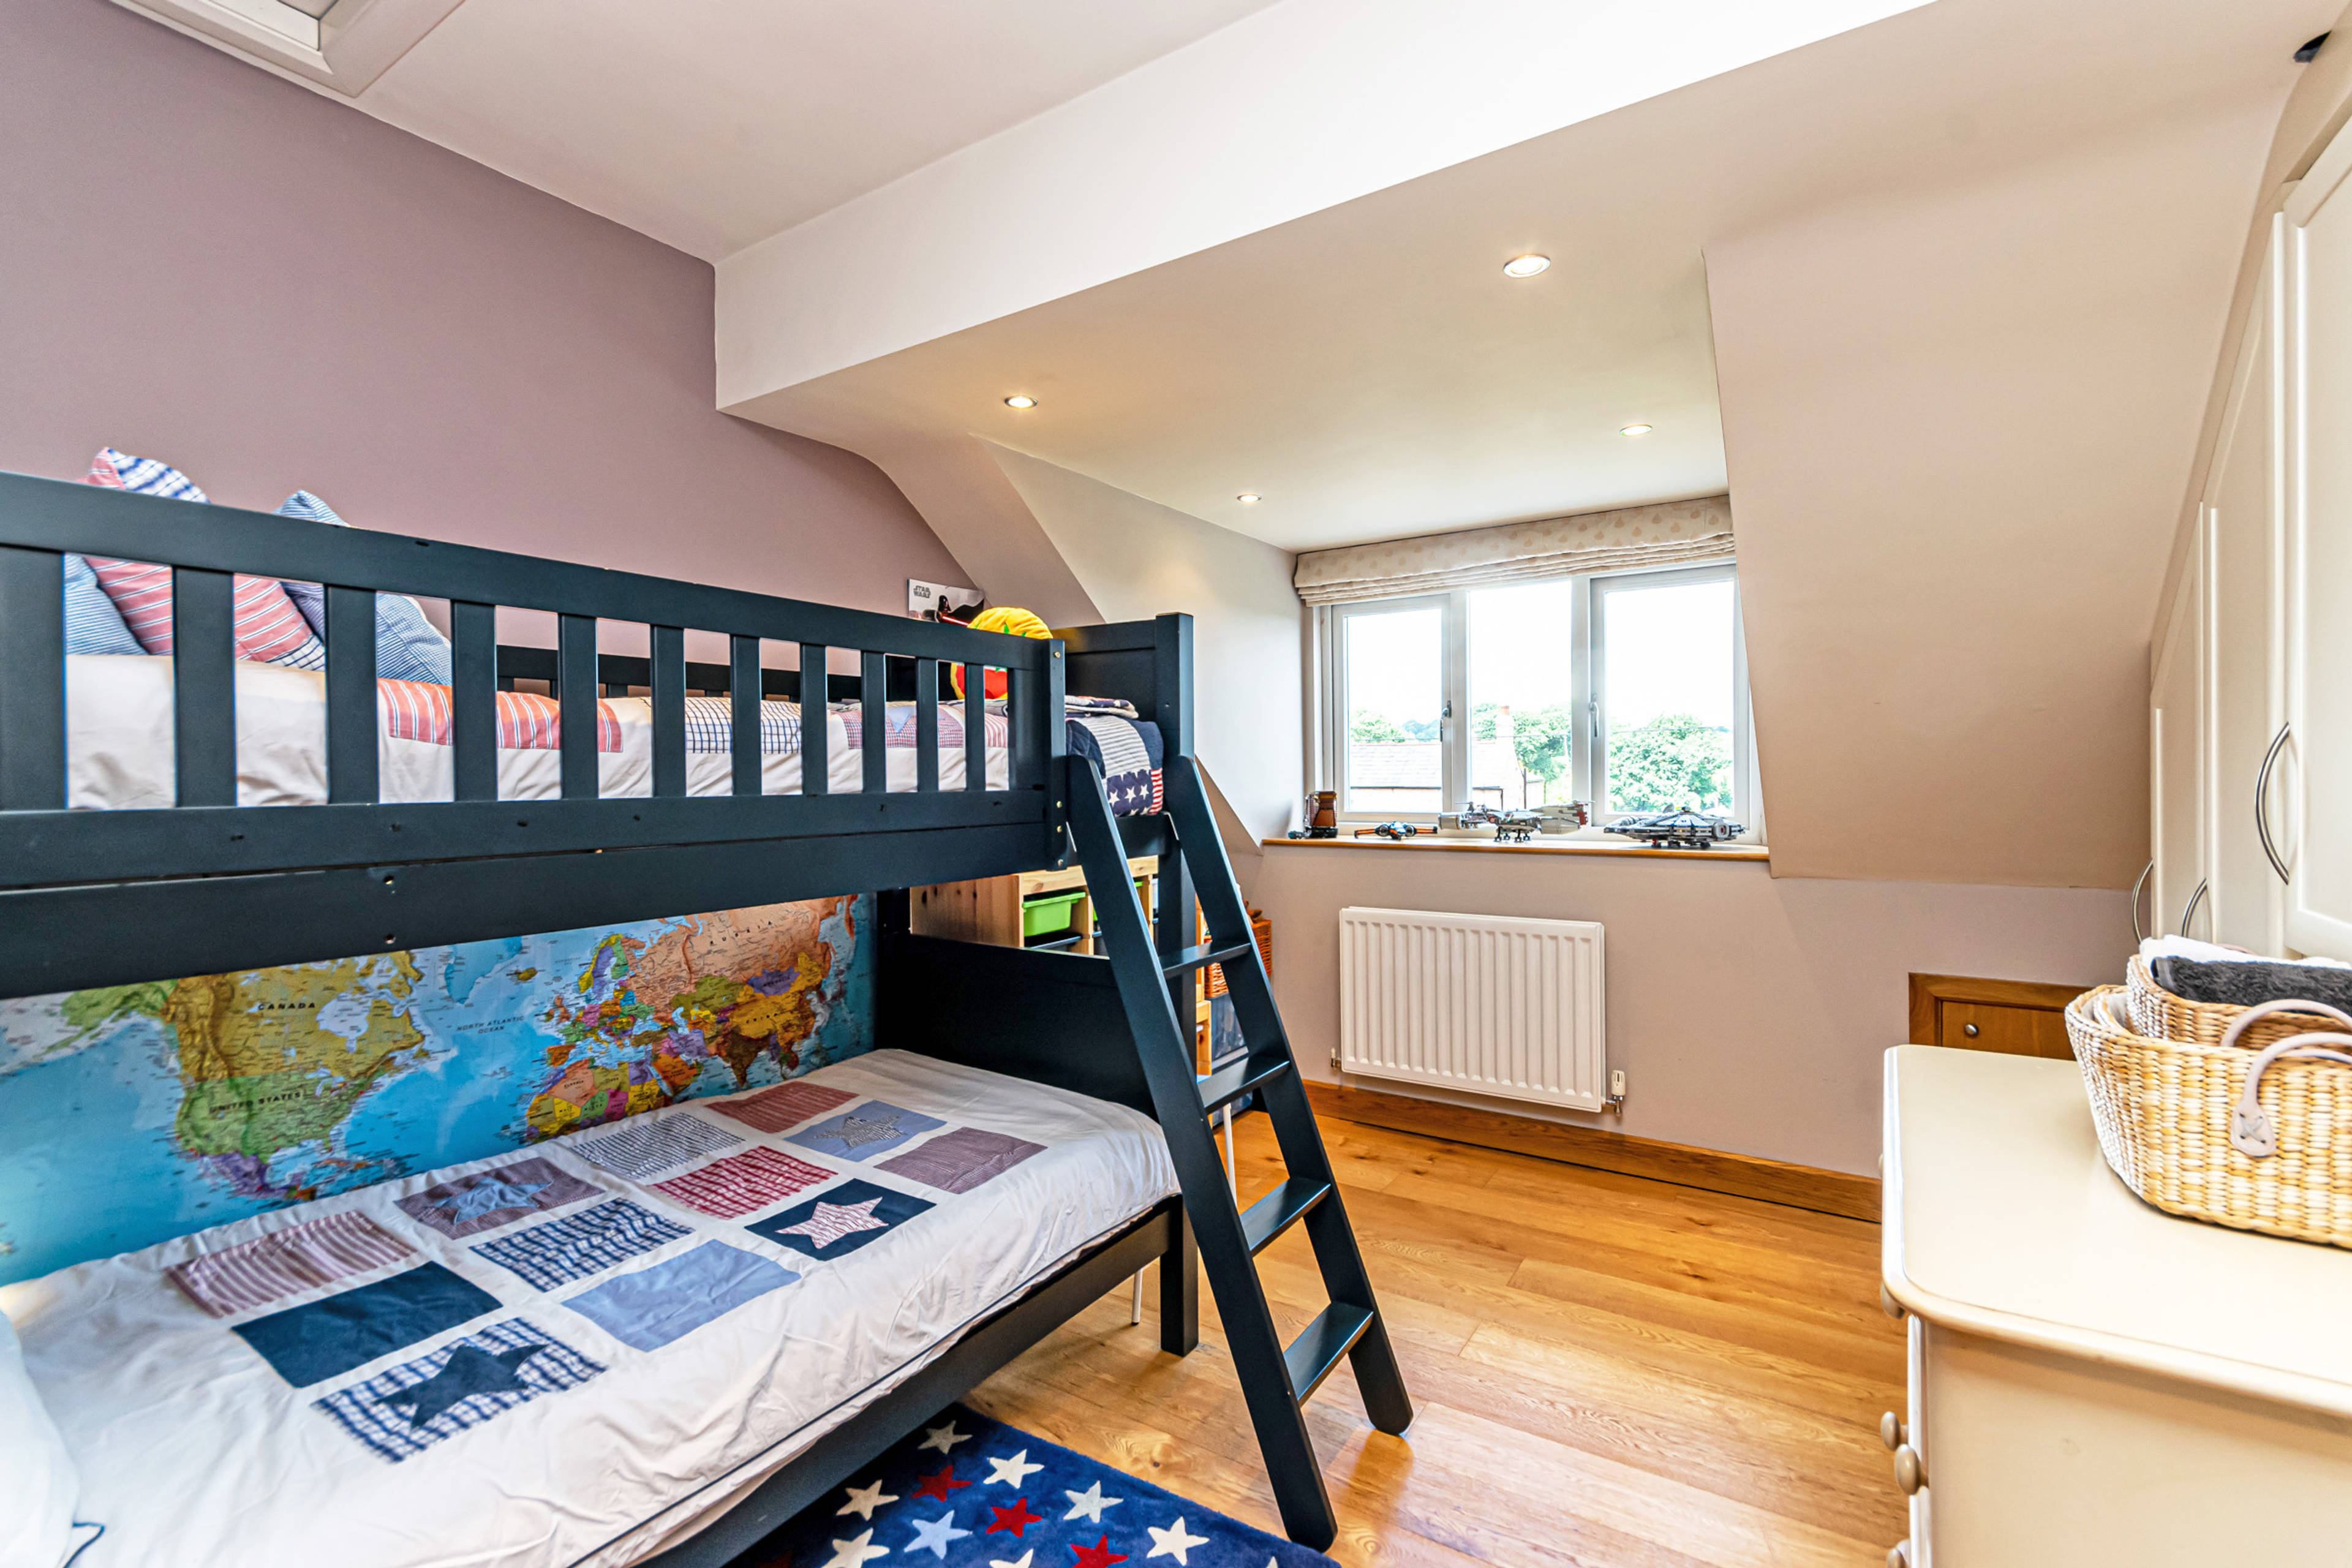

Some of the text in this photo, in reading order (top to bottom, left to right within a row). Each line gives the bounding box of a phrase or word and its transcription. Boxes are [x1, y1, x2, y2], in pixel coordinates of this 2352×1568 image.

[487, 1016, 524, 1026] ATLANTIC
[478, 1025, 505, 1034] OCEAN
[258, 1091, 300, 1104] STATES
